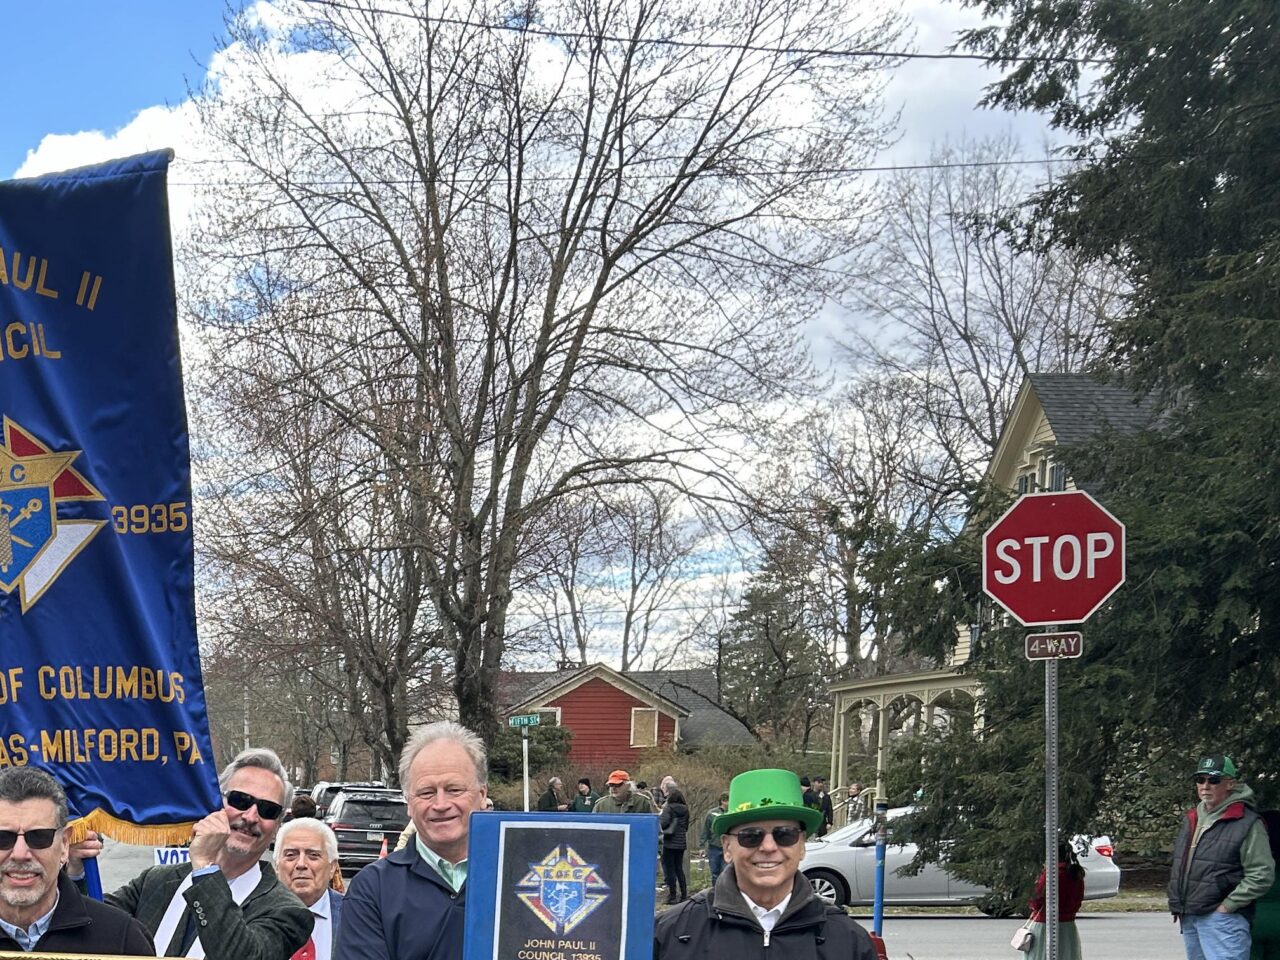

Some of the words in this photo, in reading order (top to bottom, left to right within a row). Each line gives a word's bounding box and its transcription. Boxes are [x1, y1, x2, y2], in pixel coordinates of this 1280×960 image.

[76, 271, 103, 311] II
[10, 464, 26, 483] C
[994, 532, 1115, 585] STOP
[1030, 638, 1078, 654] 4-WAY
[37, 666, 185, 704] COLUMBUS
[173, 731, 204, 765] PA
[524, 939, 556, 949] JOHN
[558, 940, 587, 951] PAUL
[589, 941, 596, 951] II
